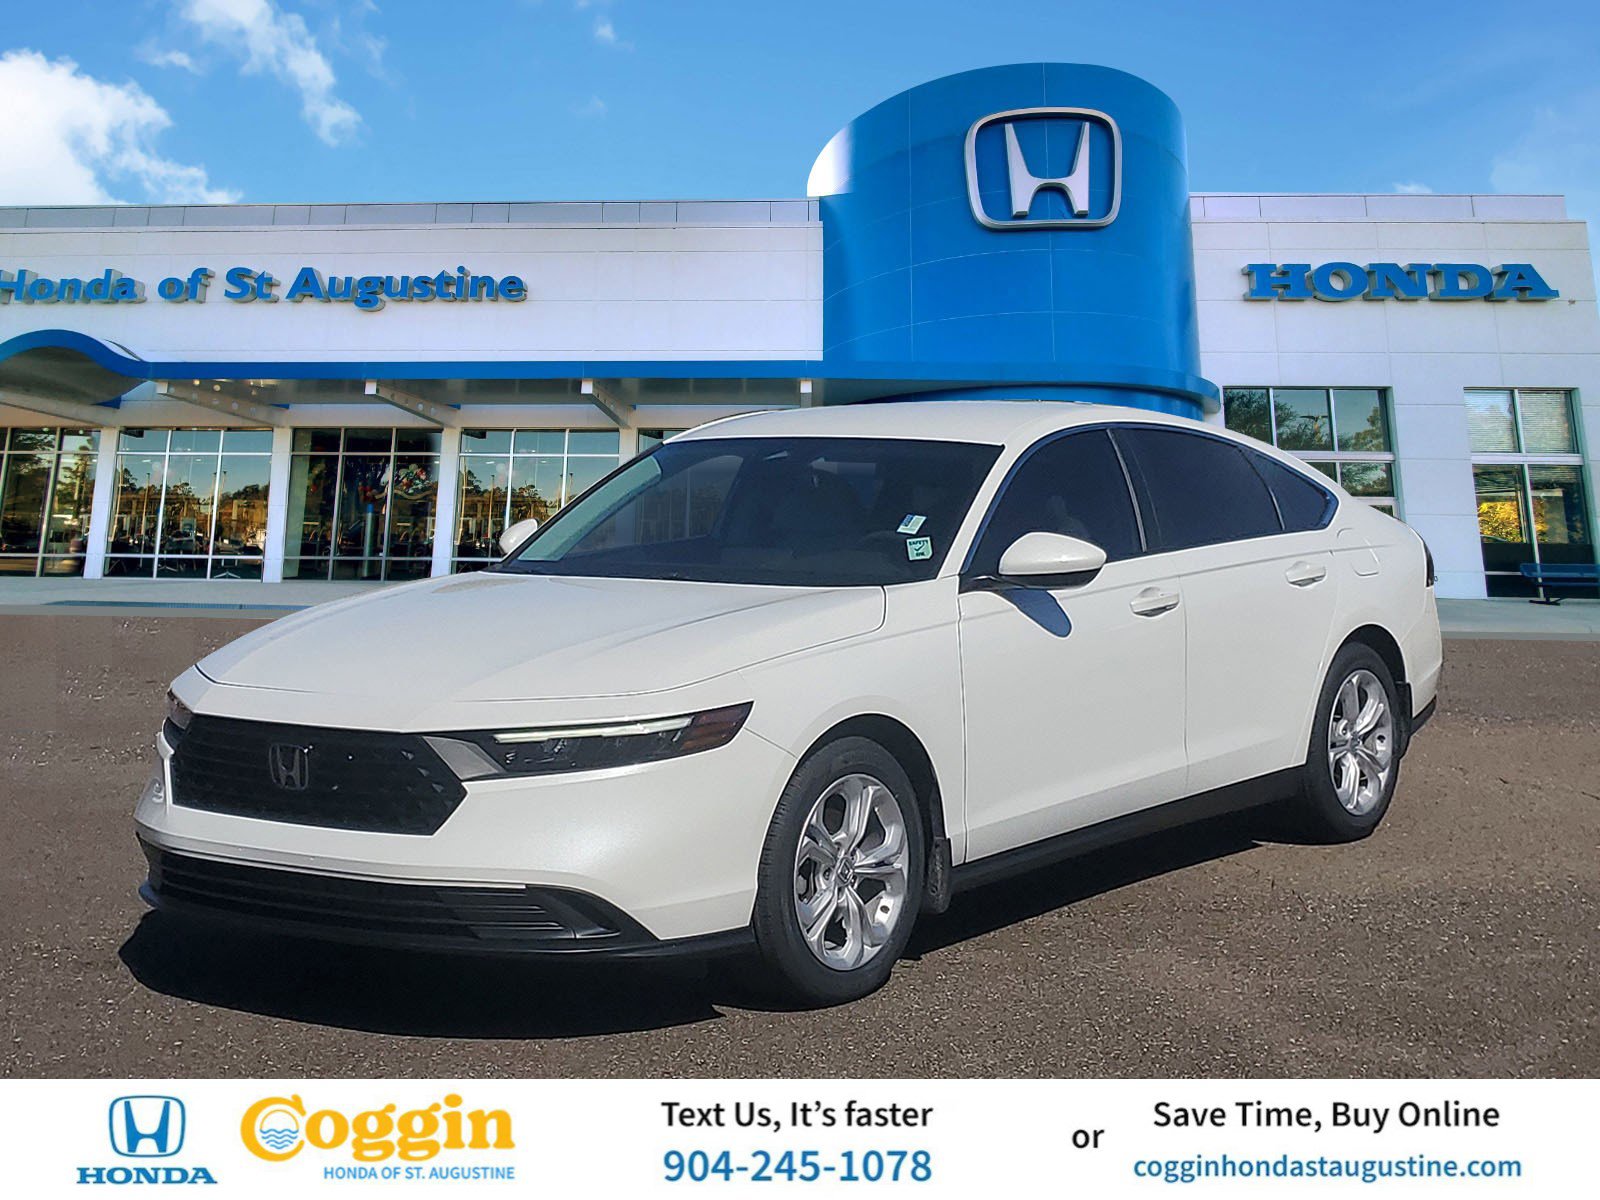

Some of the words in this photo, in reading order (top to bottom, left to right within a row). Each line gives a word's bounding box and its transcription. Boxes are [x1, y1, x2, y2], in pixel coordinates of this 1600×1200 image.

[157, 267, 215, 303] of
[284, 265, 528, 312] Augustine
[1242, 261, 1560, 302] HONDA
